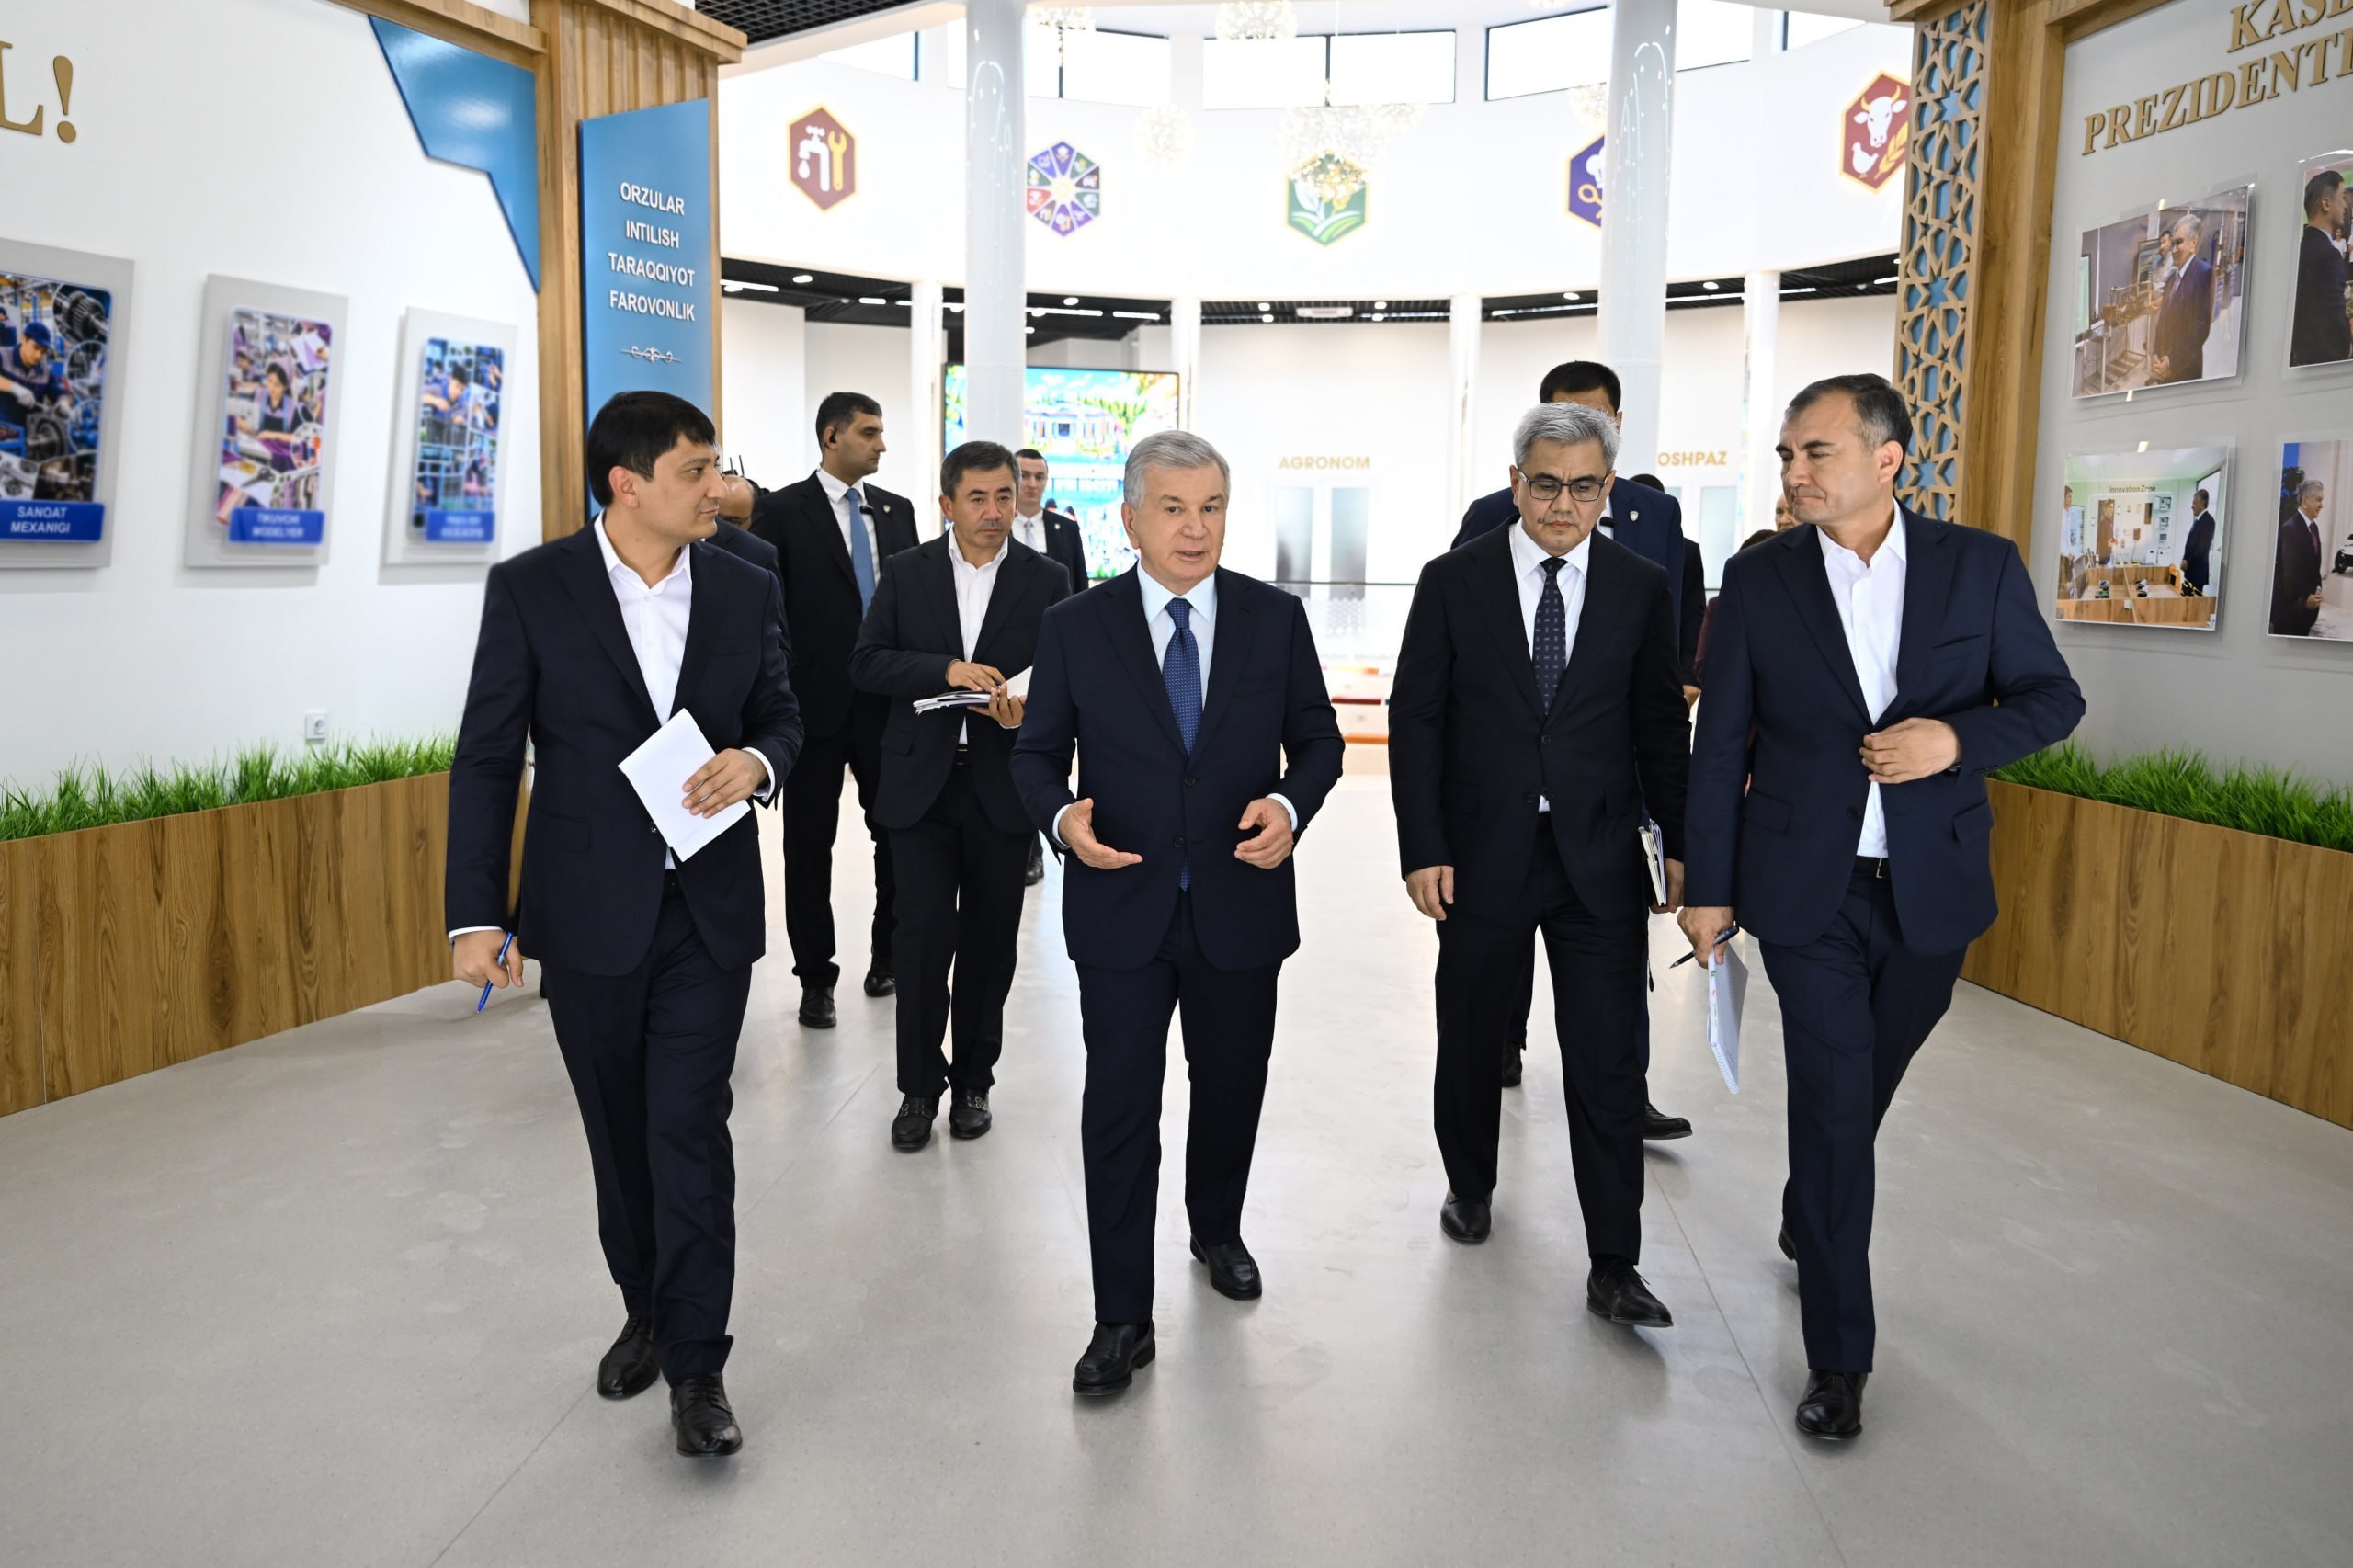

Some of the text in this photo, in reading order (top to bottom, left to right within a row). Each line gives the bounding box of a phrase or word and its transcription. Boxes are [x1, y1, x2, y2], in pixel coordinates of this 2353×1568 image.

[620, 182, 685, 216] ORZULAR
[626, 220, 680, 249] INTILISH
[608, 252, 695, 287] TARAQQIYOT
[609, 290, 695, 322] FAROVONLIK
[1279, 455, 1370, 471] AGRONOM
[1657, 451, 1728, 467] OSHPAZ
[2109, 485, 2140, 494] Innovation
[17, 506, 67, 519] SANOAT
[10, 520, 71, 533] MEXANIGI
